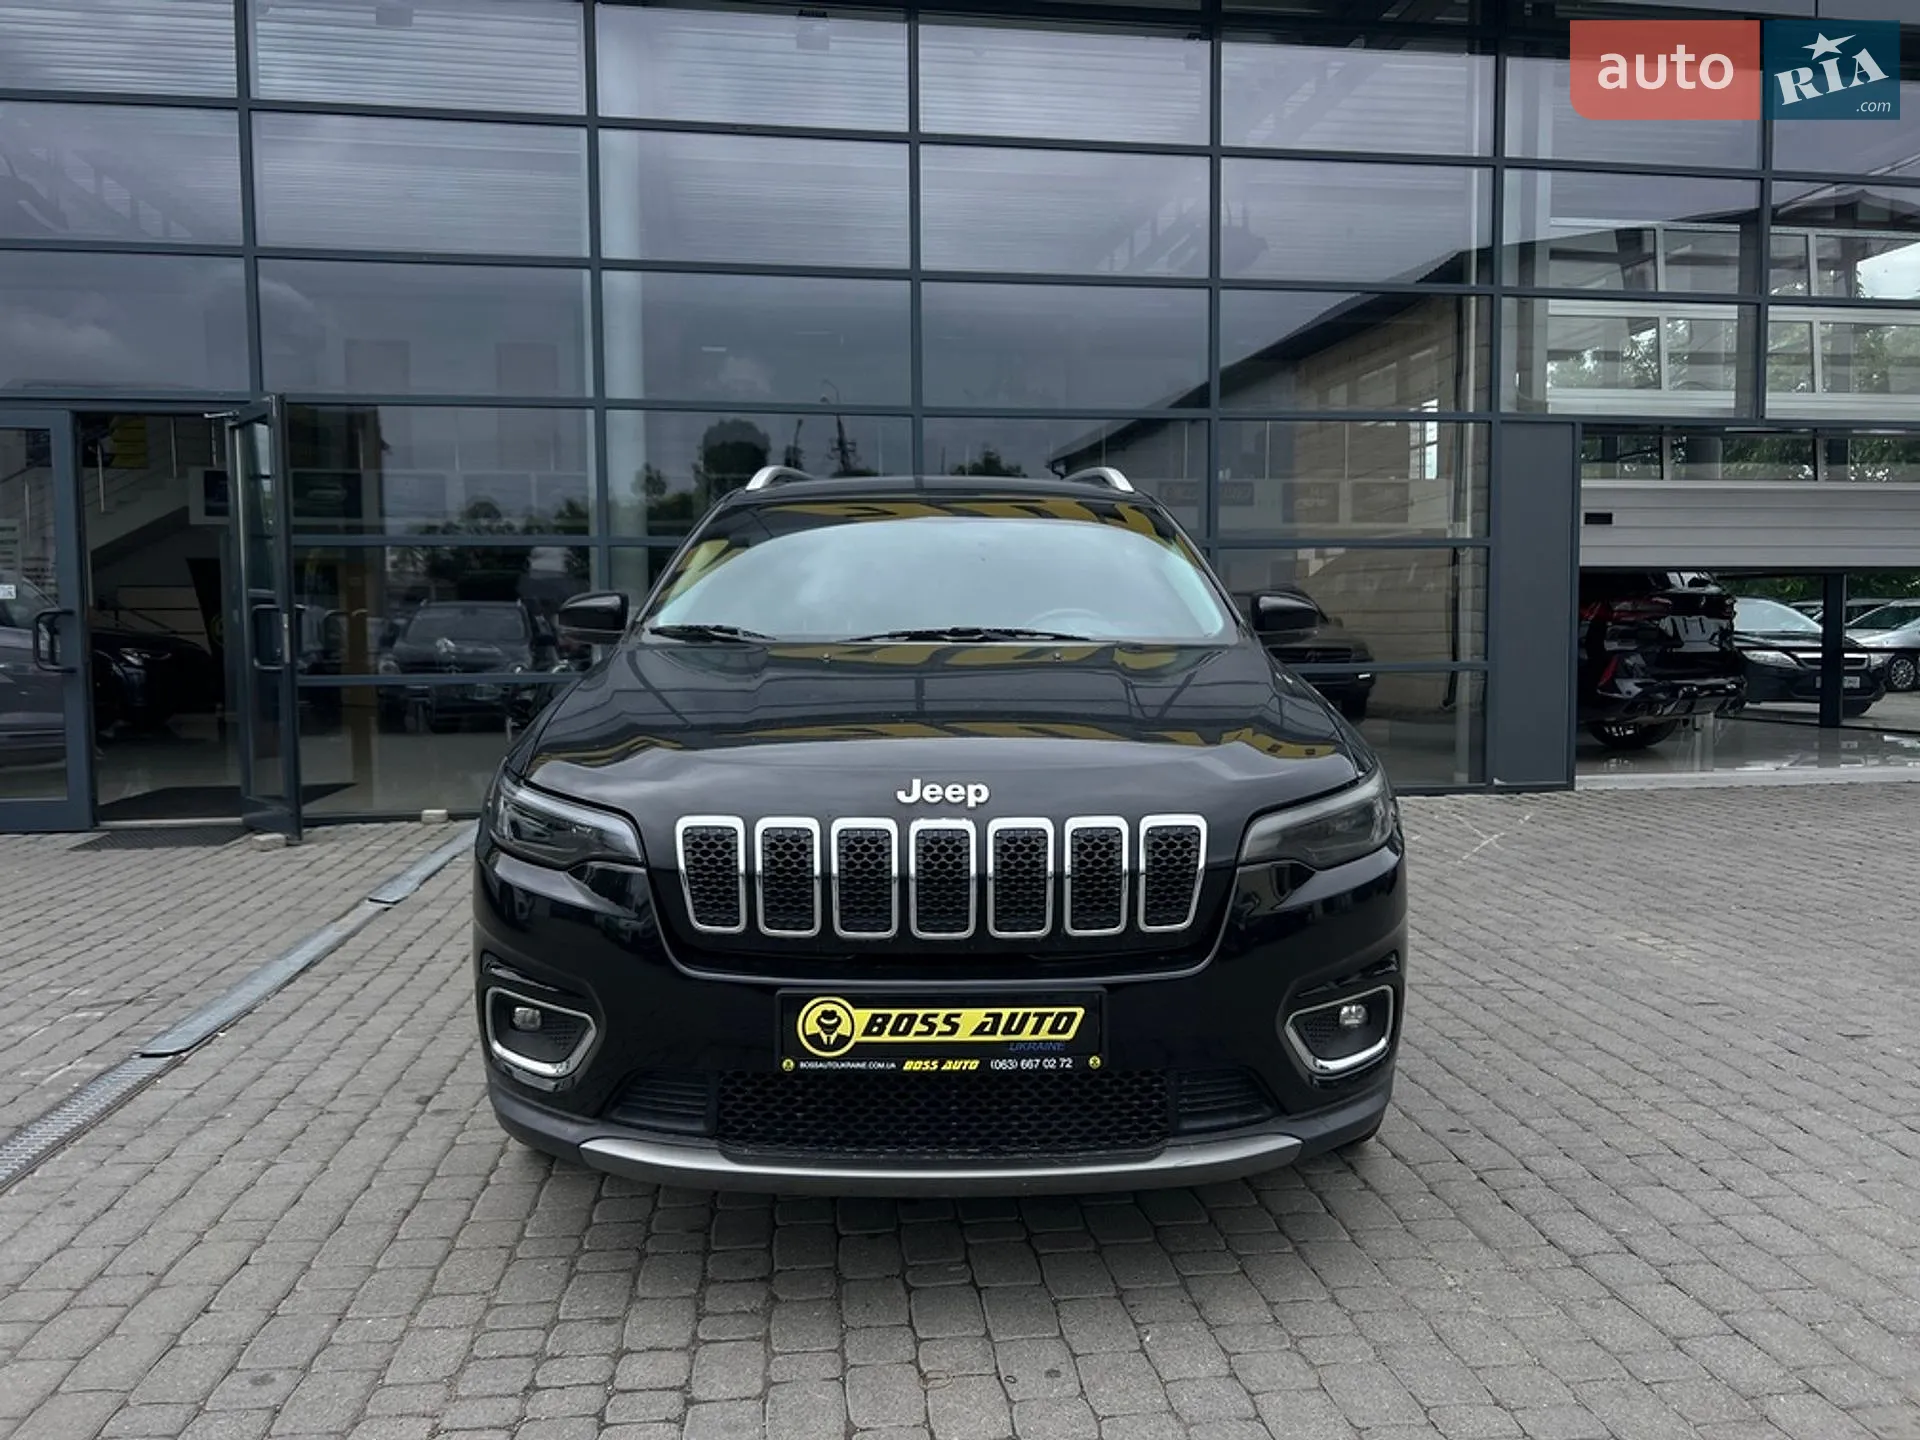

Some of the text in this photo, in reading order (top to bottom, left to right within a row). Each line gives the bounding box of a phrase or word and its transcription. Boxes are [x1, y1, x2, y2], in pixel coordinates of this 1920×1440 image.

[897, 778, 989, 807] Jeep
[861, 1011, 1079, 1037] BOSS AUTO
[1008, 1041, 1066, 1051] UKRAINE
[902, 1060, 939, 1071] BOSS
[940, 1060, 980, 1070] AUTO
[989, 1058, 1018, 1070] (063)
[1020, 1058, 1041, 1070] 667
[1042, 1058, 1057, 1069] 02
[1059, 1057, 1074, 1068] 72
